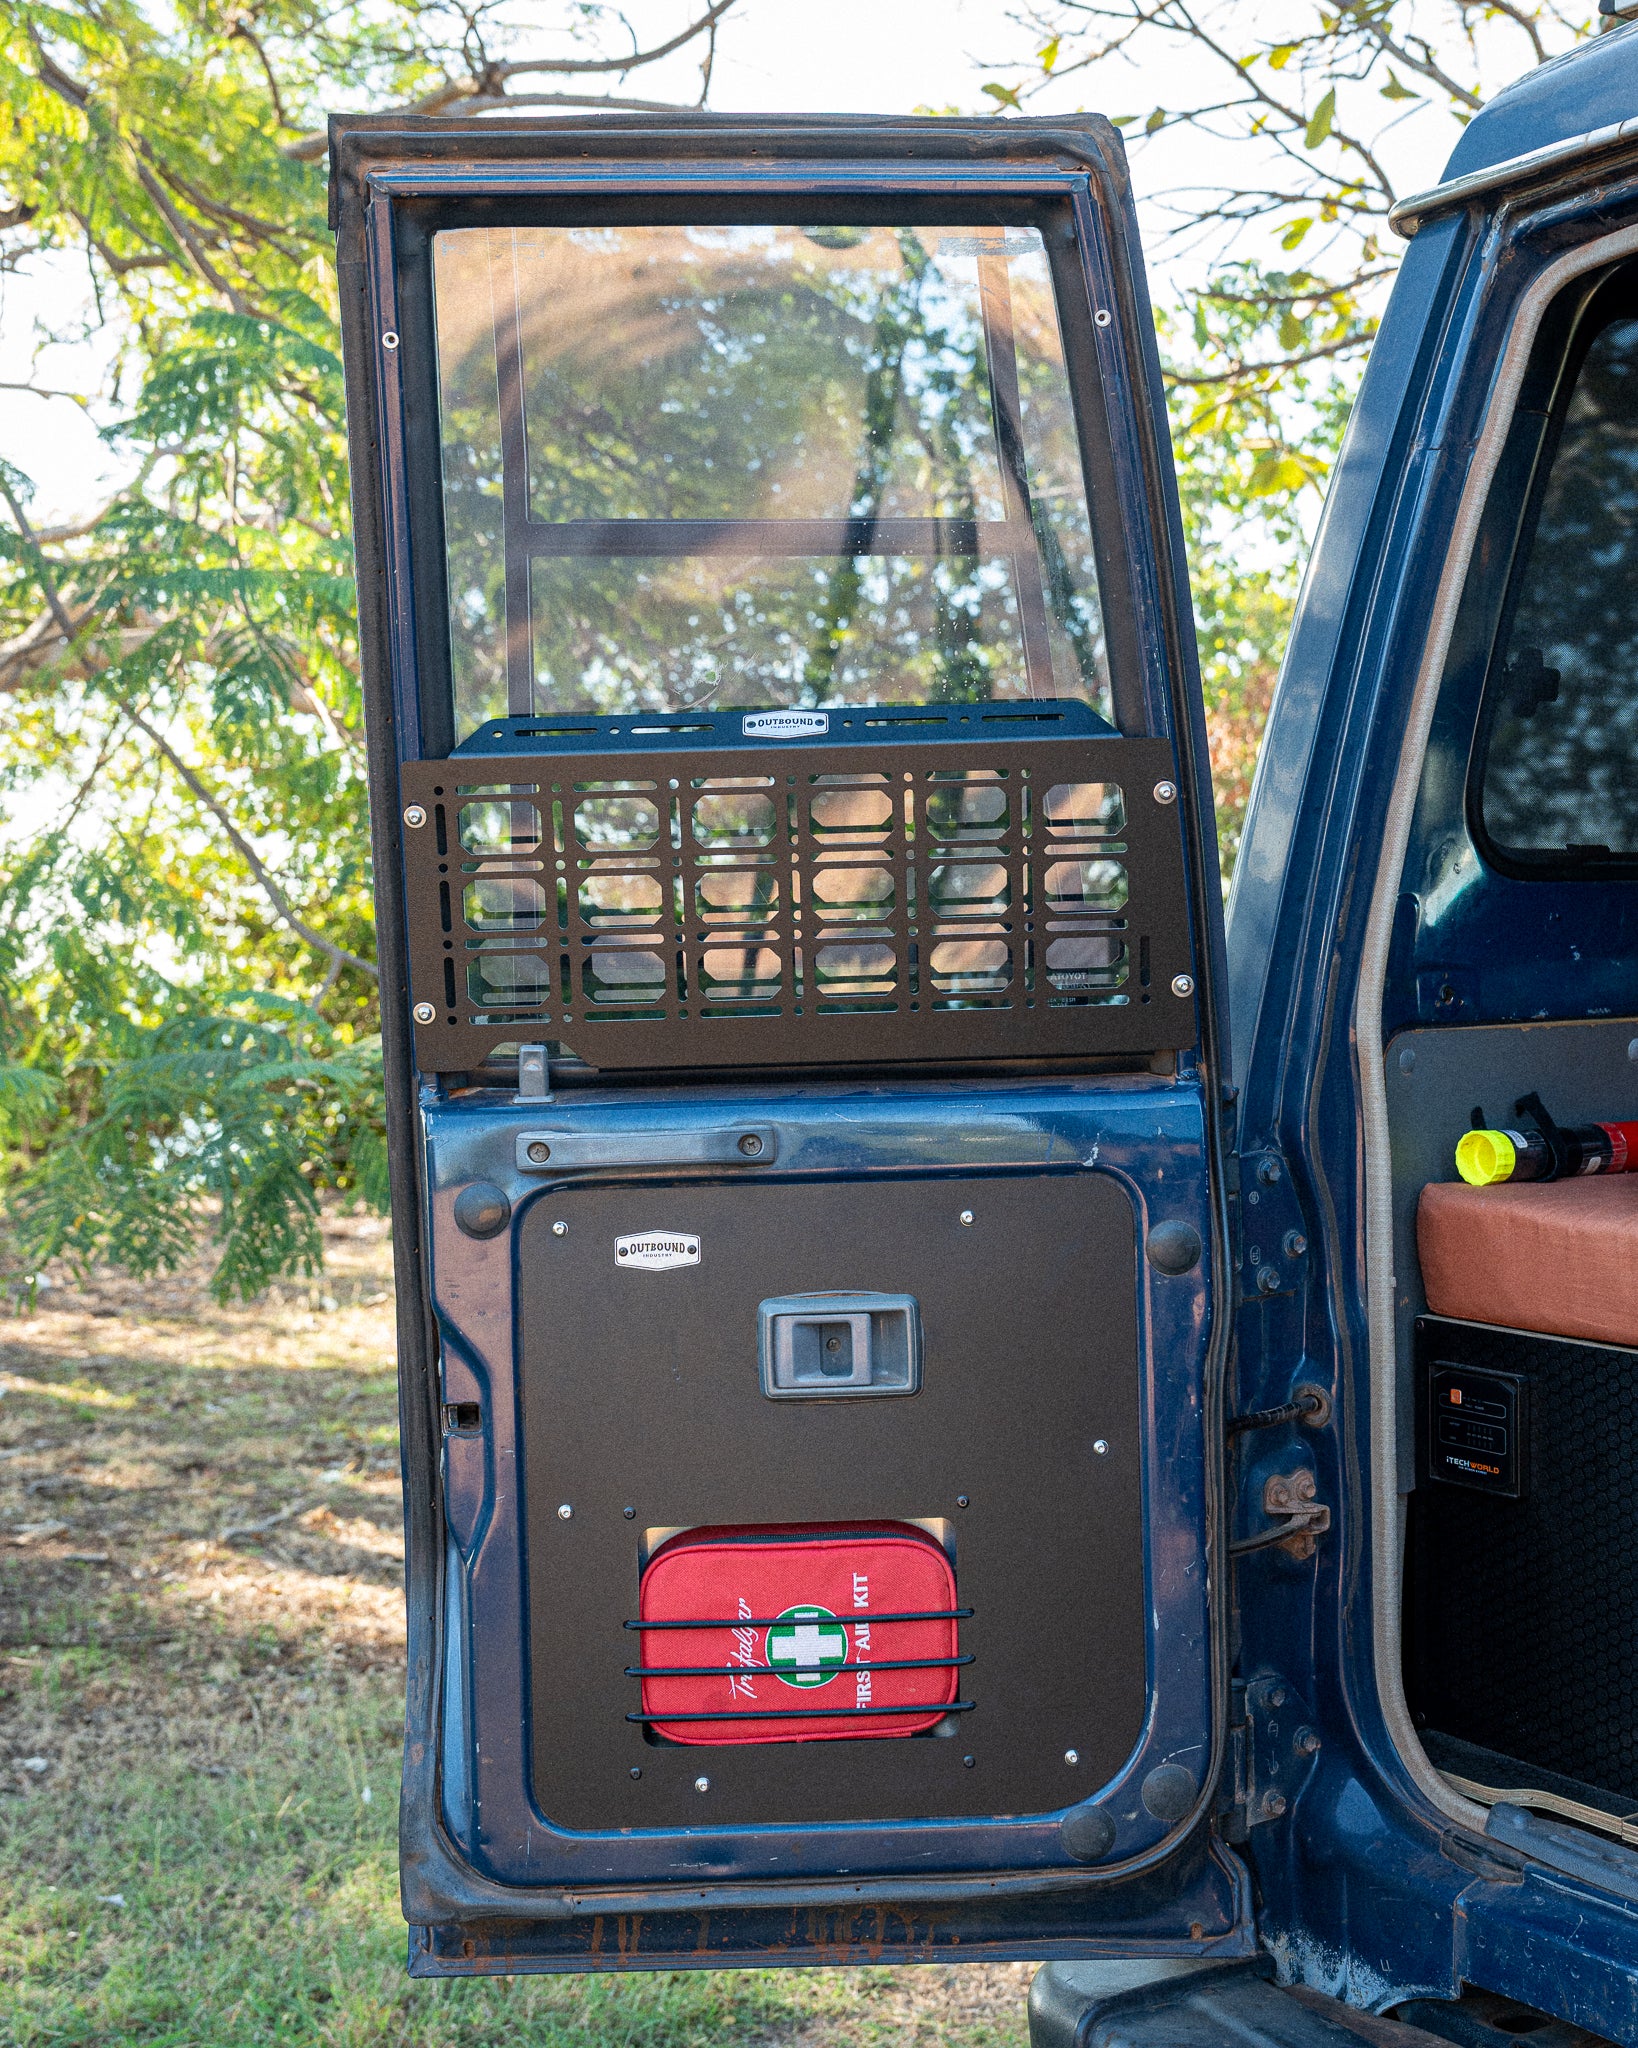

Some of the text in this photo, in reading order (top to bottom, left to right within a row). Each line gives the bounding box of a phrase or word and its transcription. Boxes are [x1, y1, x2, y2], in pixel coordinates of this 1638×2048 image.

[757, 718, 814, 728] OUTBOUND
[629, 1242, 686, 1255] OUTBOUND
[852, 1572, 869, 1608] KIT
